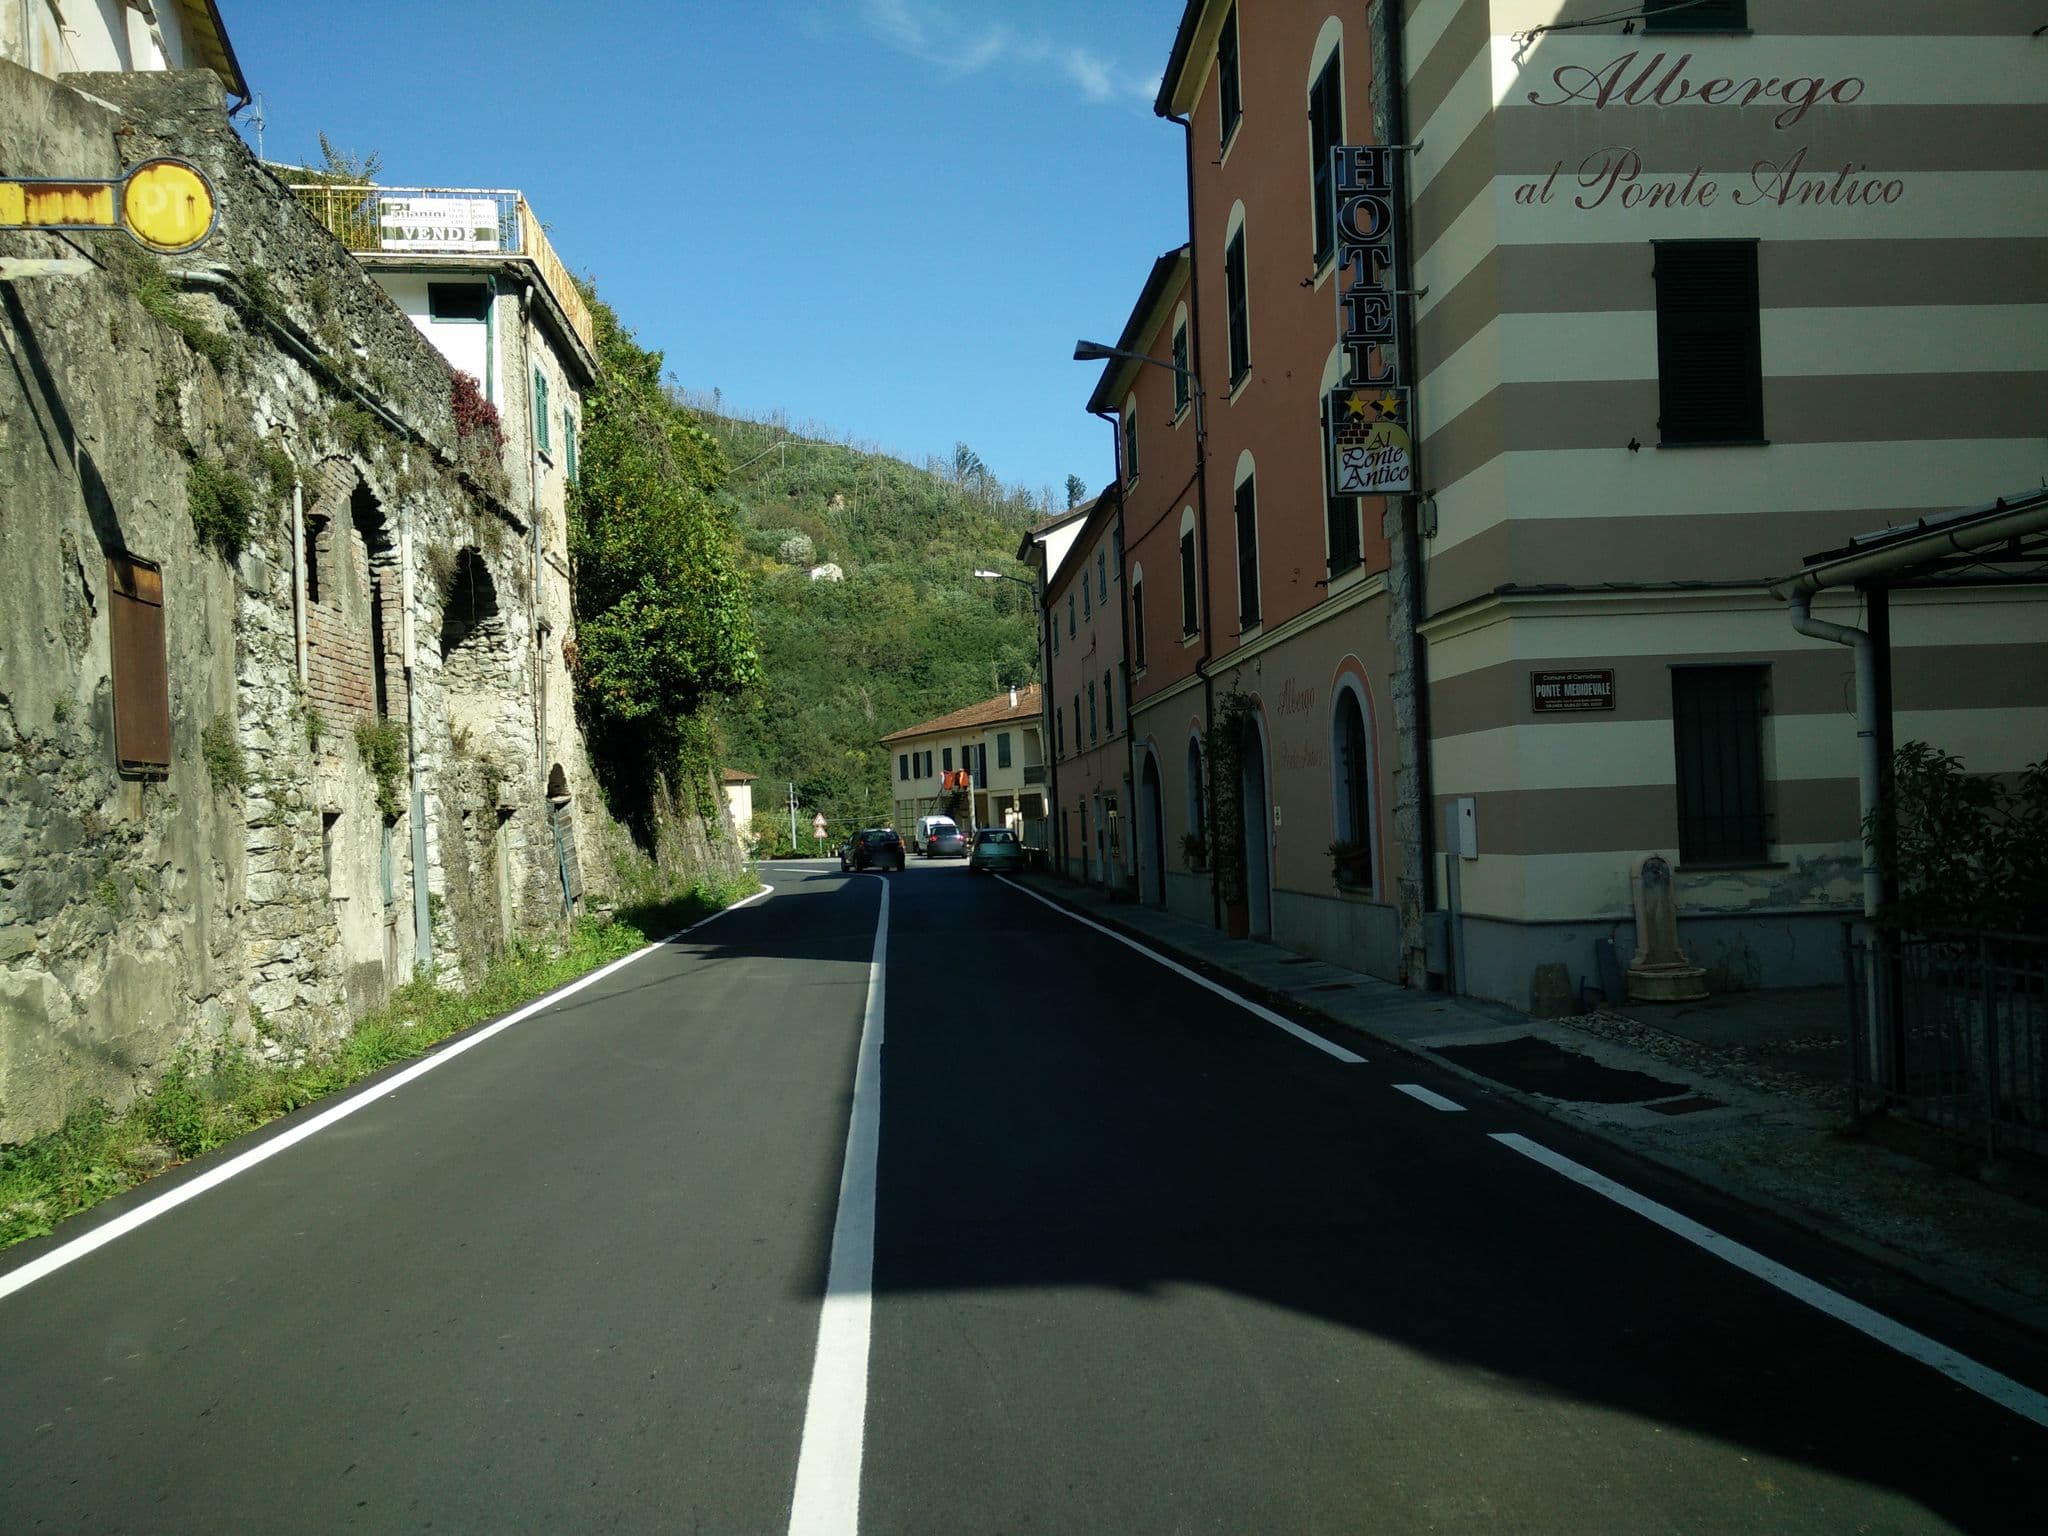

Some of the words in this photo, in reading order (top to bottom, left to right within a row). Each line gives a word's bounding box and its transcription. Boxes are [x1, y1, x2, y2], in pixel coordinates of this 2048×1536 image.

[1527, 50, 1865, 130] Albergo
[1513, 160, 1564, 205] al
[1574, 145, 1718, 210] Ponte
[1731, 145, 1904, 207] Antico
[402, 226, 478, 240] VENDE
[1336, 145, 1397, 387] HOTEL
[1366, 430, 1392, 451] Al
[1343, 446, 1405, 472] Ponte
[1341, 465, 1410, 491] Antico
[1535, 684, 1561, 698] PONTE
[1564, 682, 1611, 697] MEDIOEVALE
